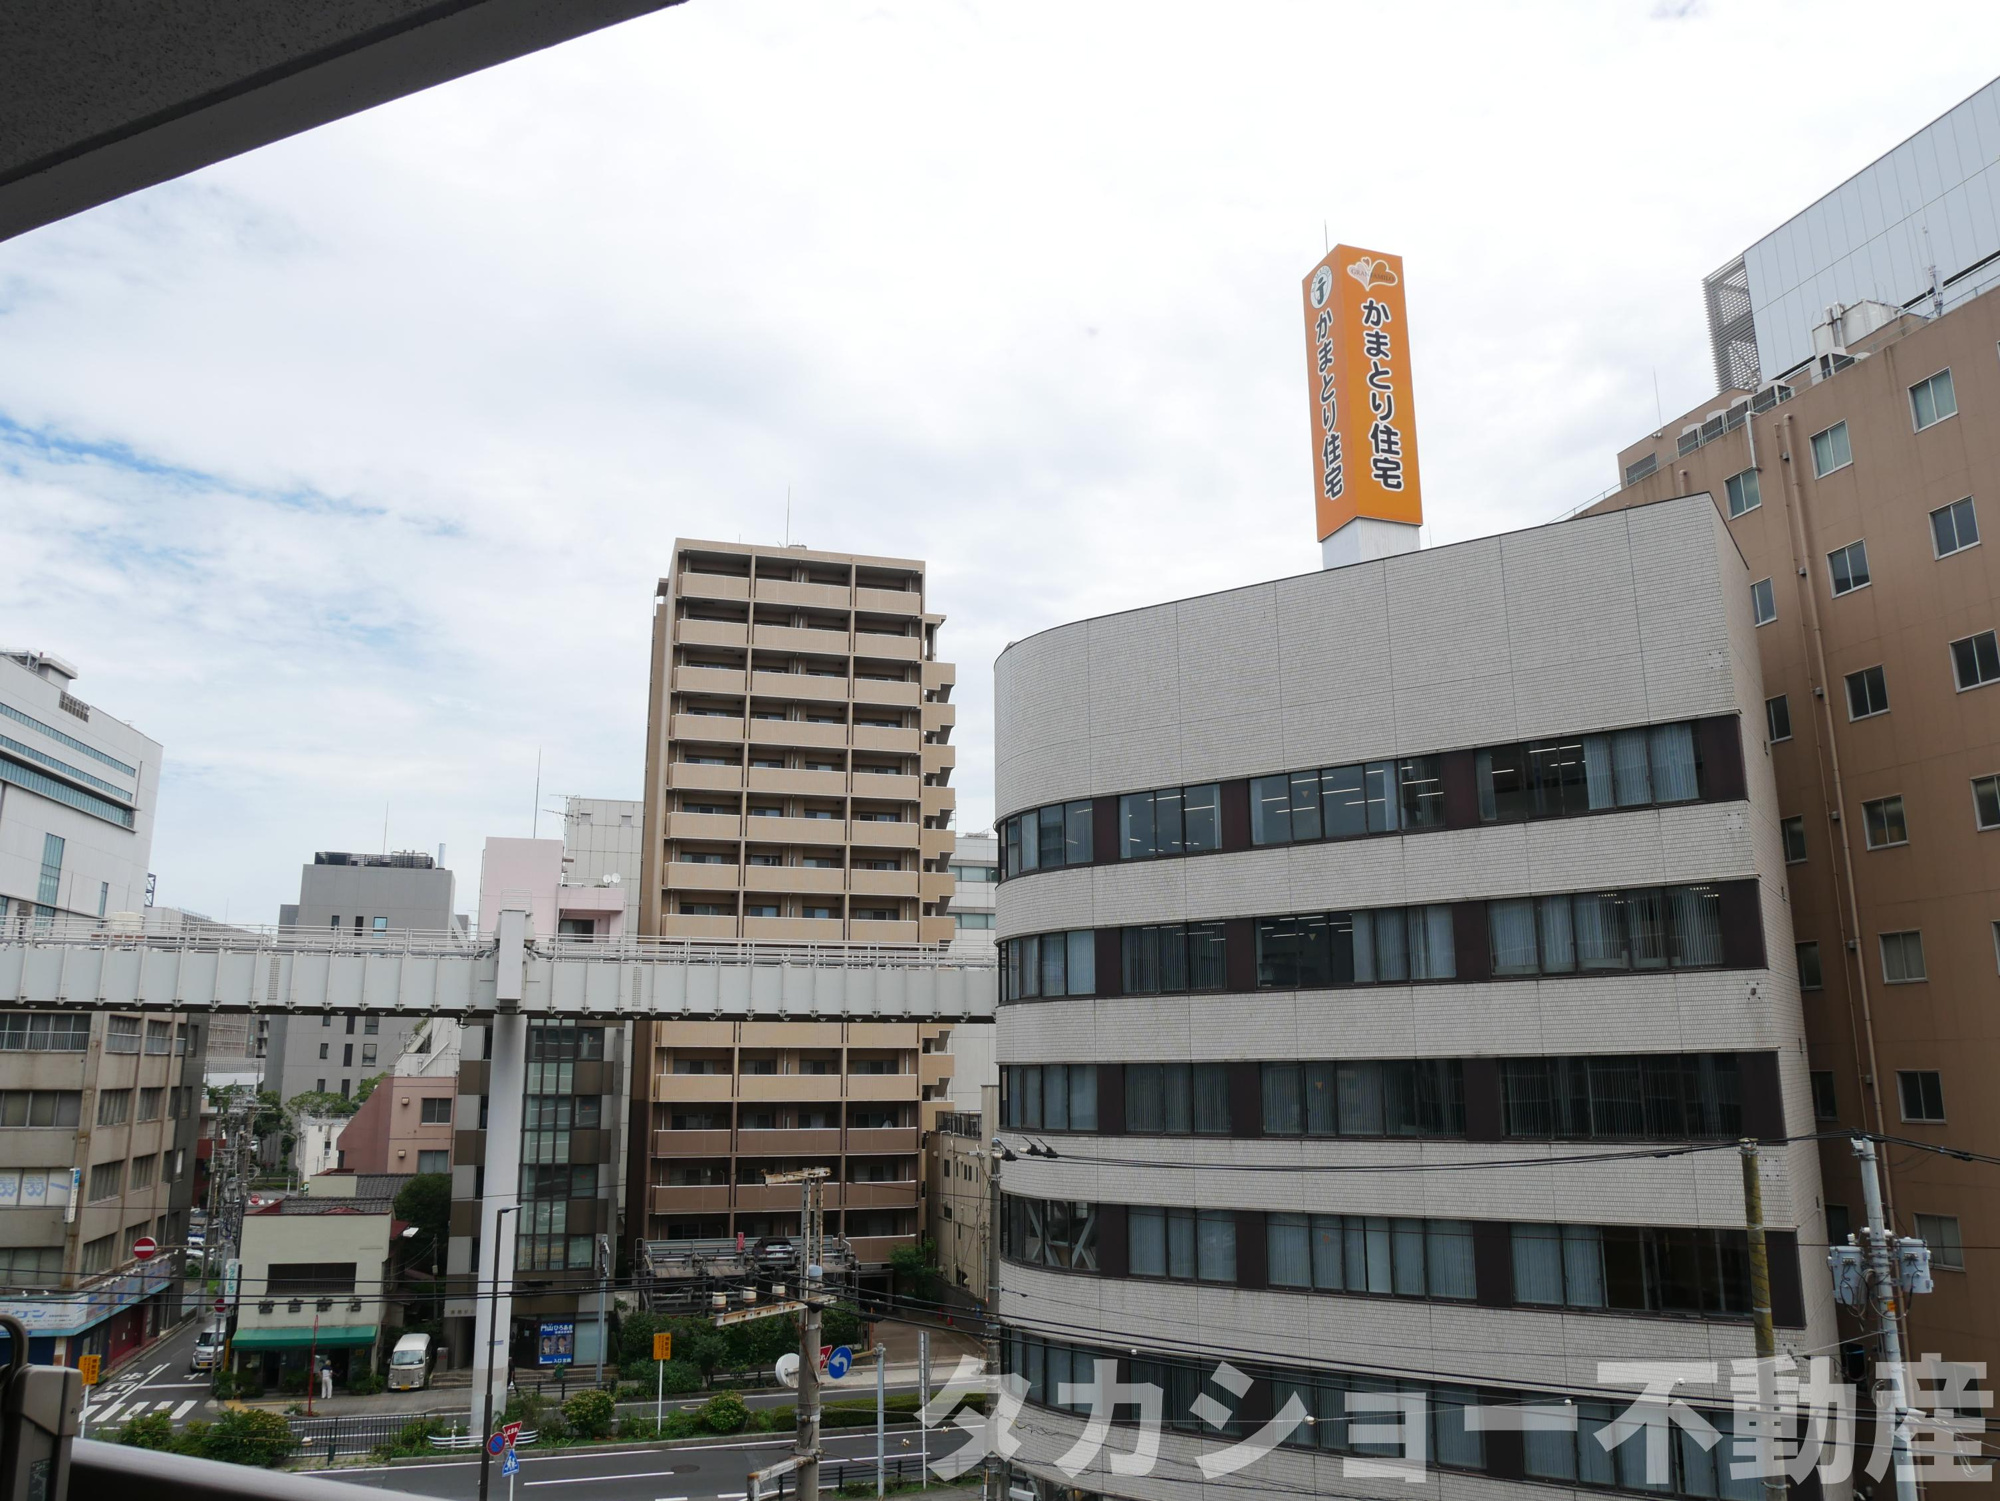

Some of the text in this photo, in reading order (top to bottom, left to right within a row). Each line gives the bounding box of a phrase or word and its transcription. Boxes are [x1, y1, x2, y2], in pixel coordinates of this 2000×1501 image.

[1316, 309, 1343, 500] かまとり住宅
[1362, 298, 1404, 491] かまとり住宅
